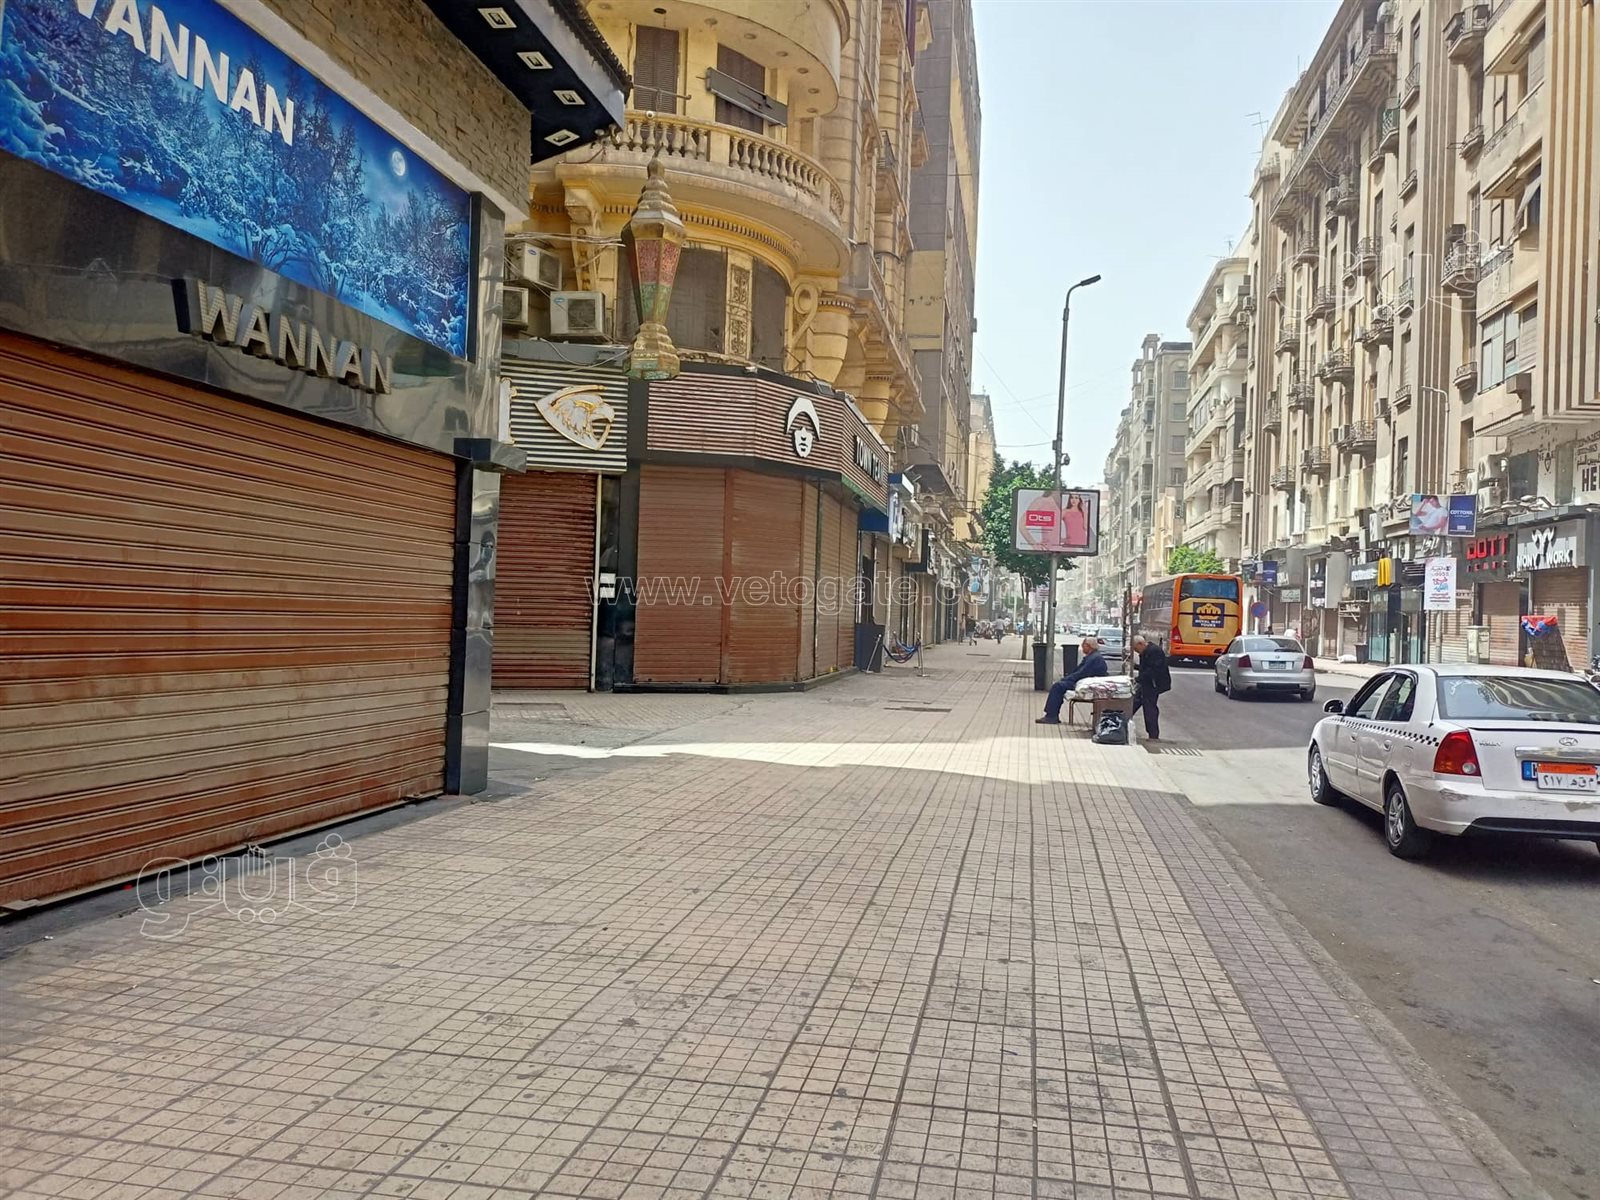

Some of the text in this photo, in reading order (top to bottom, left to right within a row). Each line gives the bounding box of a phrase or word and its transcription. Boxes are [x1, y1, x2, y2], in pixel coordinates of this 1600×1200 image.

[75, 0, 294, 147] ANNAN
[194, 279, 392, 395] WANNAN
[1582, 466, 1600, 492] HE
[1546, 548, 1572, 568] WORK
